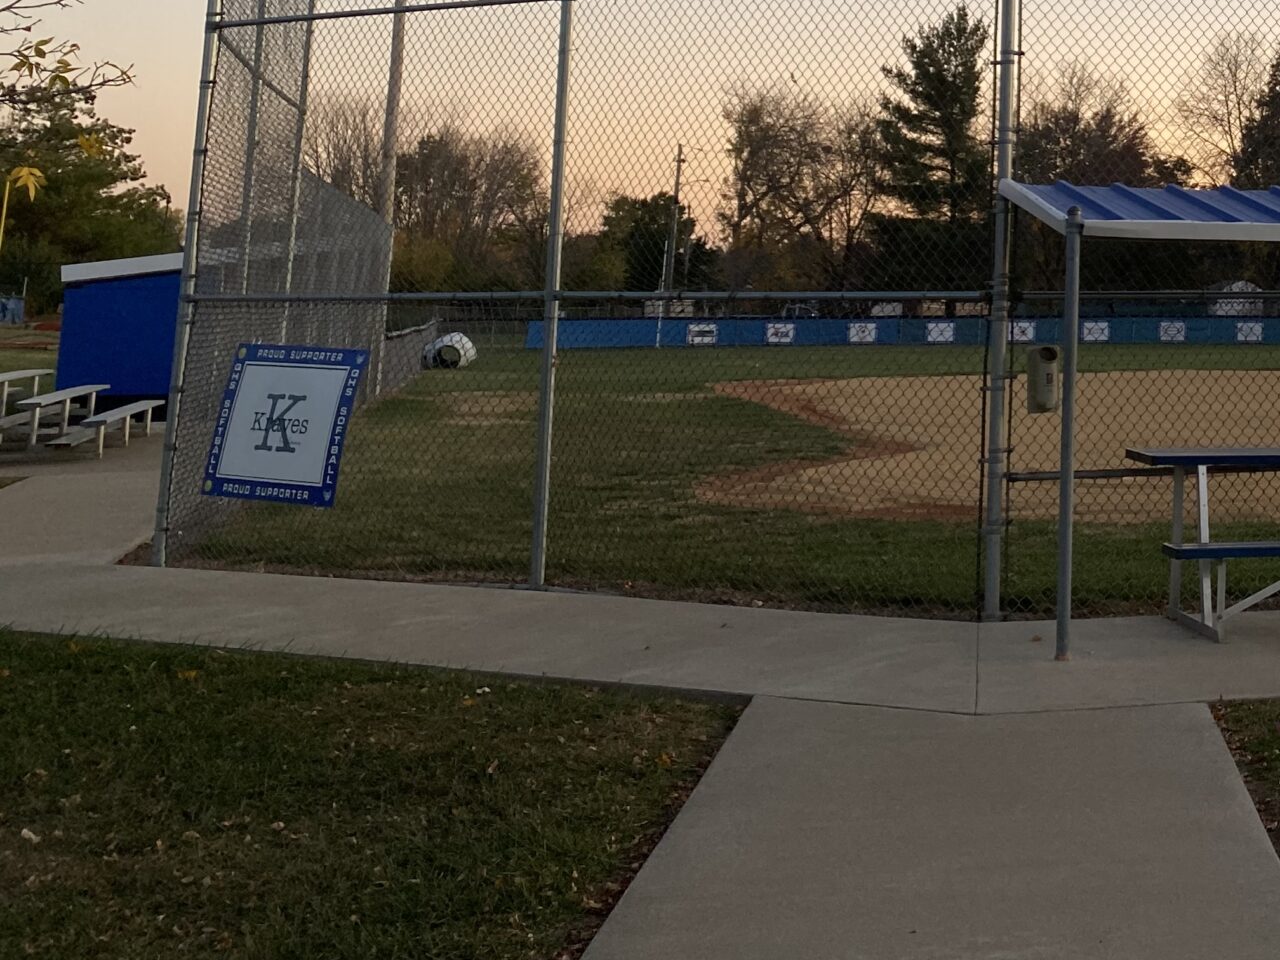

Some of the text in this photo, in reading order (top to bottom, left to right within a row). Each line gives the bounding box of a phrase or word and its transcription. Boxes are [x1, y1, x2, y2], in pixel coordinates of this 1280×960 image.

[257, 349, 344, 362] PROUD SUPPORTER
[208, 399, 231, 474] SOFTBALL
[326, 406, 347, 484] SOFTBALL
[222, 483, 309, 500] PROUD SUPPORTER
